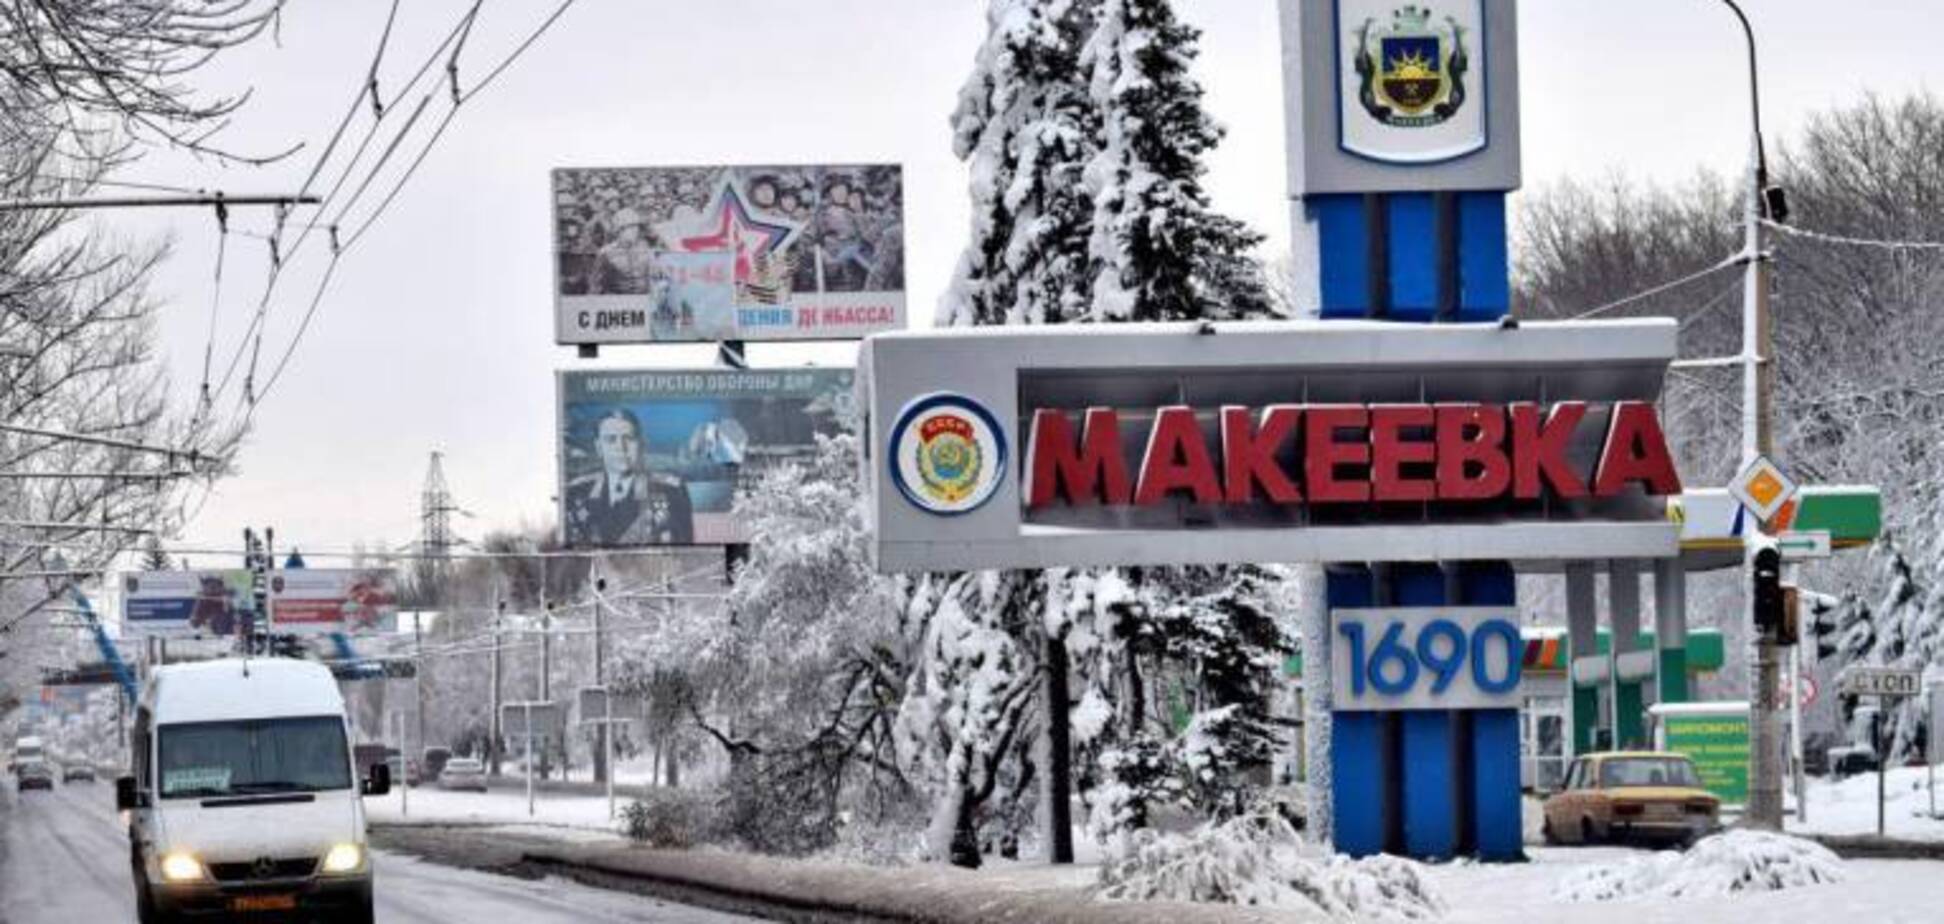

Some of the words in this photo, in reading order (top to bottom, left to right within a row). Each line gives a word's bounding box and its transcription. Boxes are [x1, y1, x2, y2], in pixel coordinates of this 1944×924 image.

[578, 310, 590, 329] С
[595, 310, 646, 330] ДНЕМ
[1024, 402, 1682, 505] МАКЕЕВКА
[1339, 618, 1521, 698] 1690
